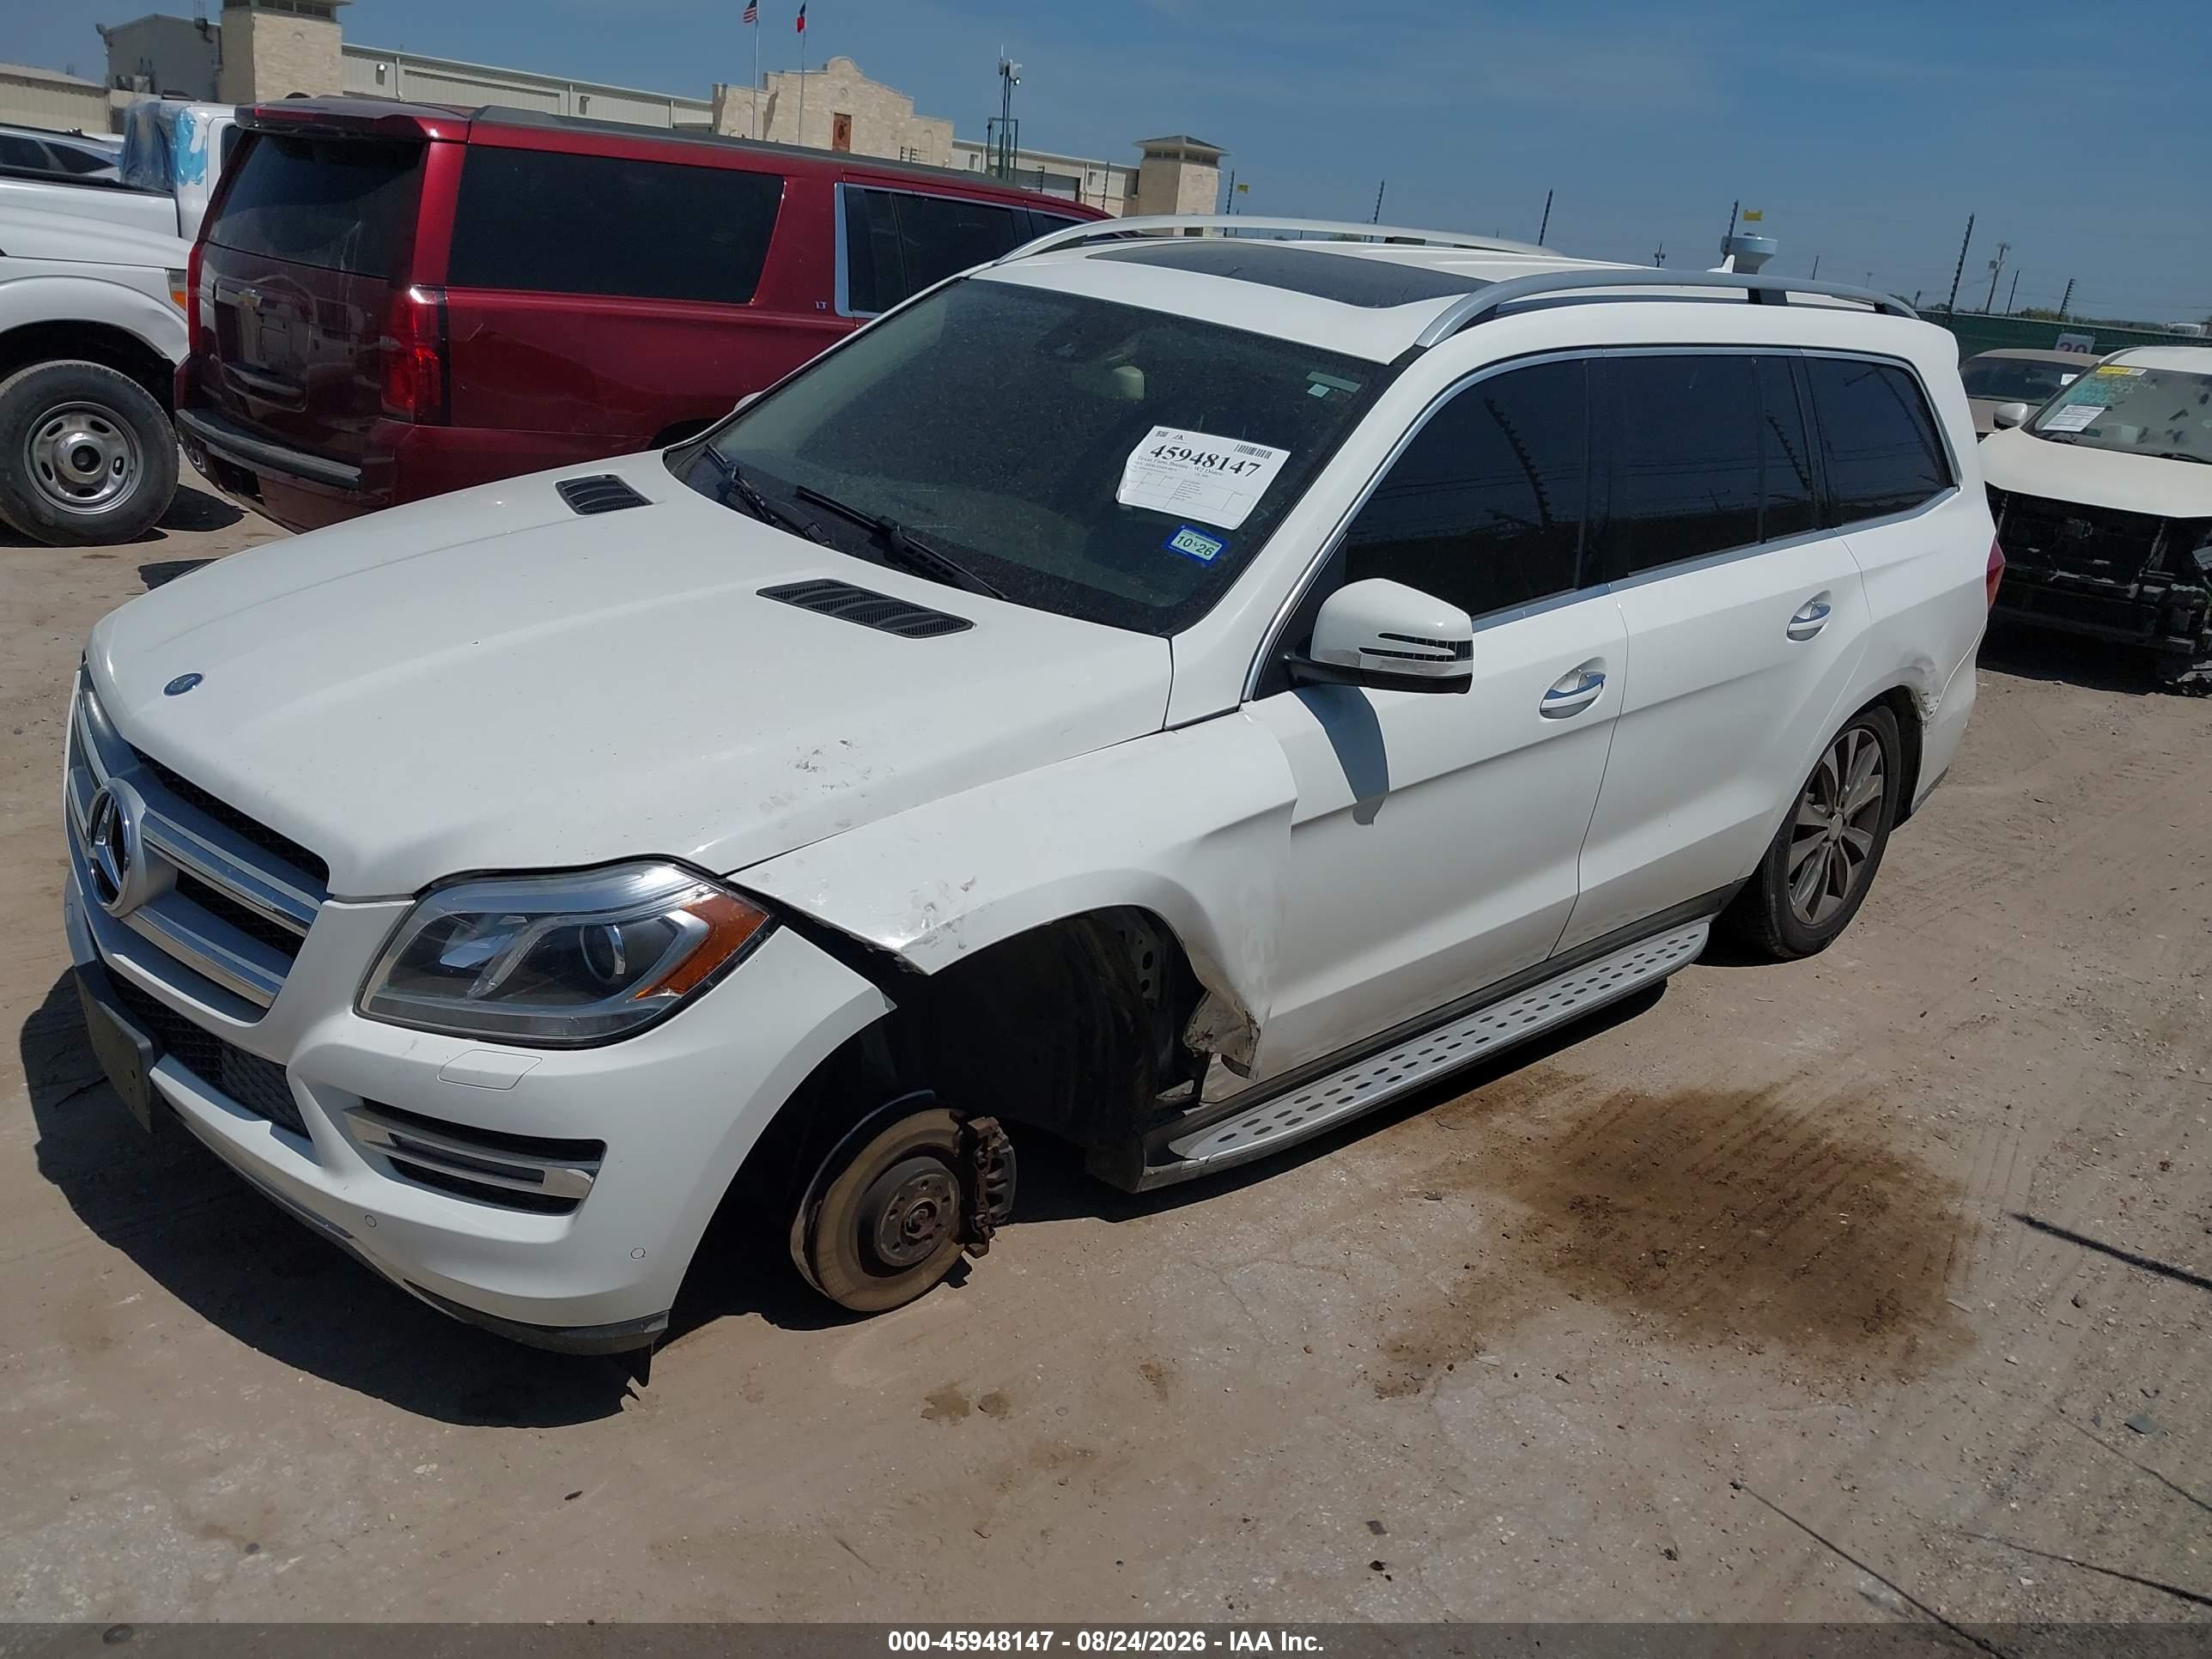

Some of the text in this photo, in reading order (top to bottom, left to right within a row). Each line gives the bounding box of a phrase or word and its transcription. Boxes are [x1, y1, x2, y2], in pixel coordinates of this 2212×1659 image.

[1150, 444, 1261, 477] 45948147
[1176, 536, 1194, 548] 10
[1194, 544, 1215, 556] 26
